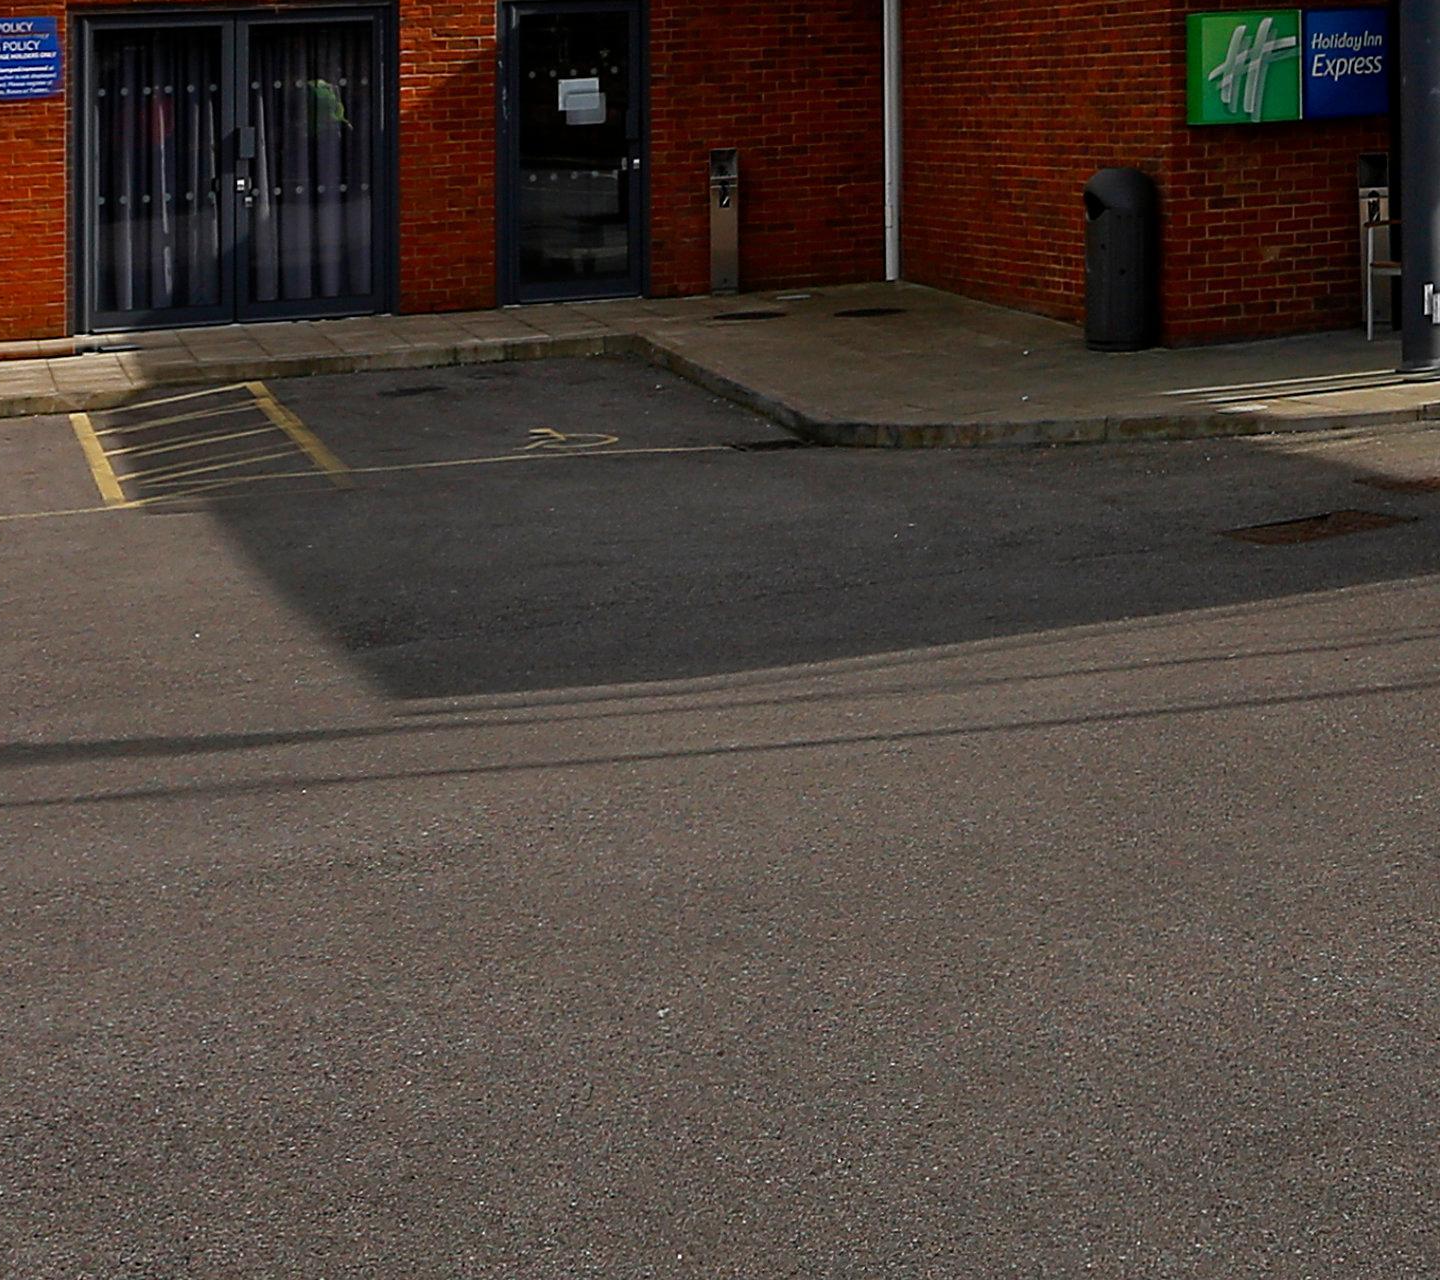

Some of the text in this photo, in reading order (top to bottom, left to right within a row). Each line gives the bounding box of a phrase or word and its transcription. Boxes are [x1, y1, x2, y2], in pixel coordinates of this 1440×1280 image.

[2, 39, 41, 52] POLICY
[1311, 29, 1383, 51] Holiday Inn
[1311, 52, 1383, 82] Express
